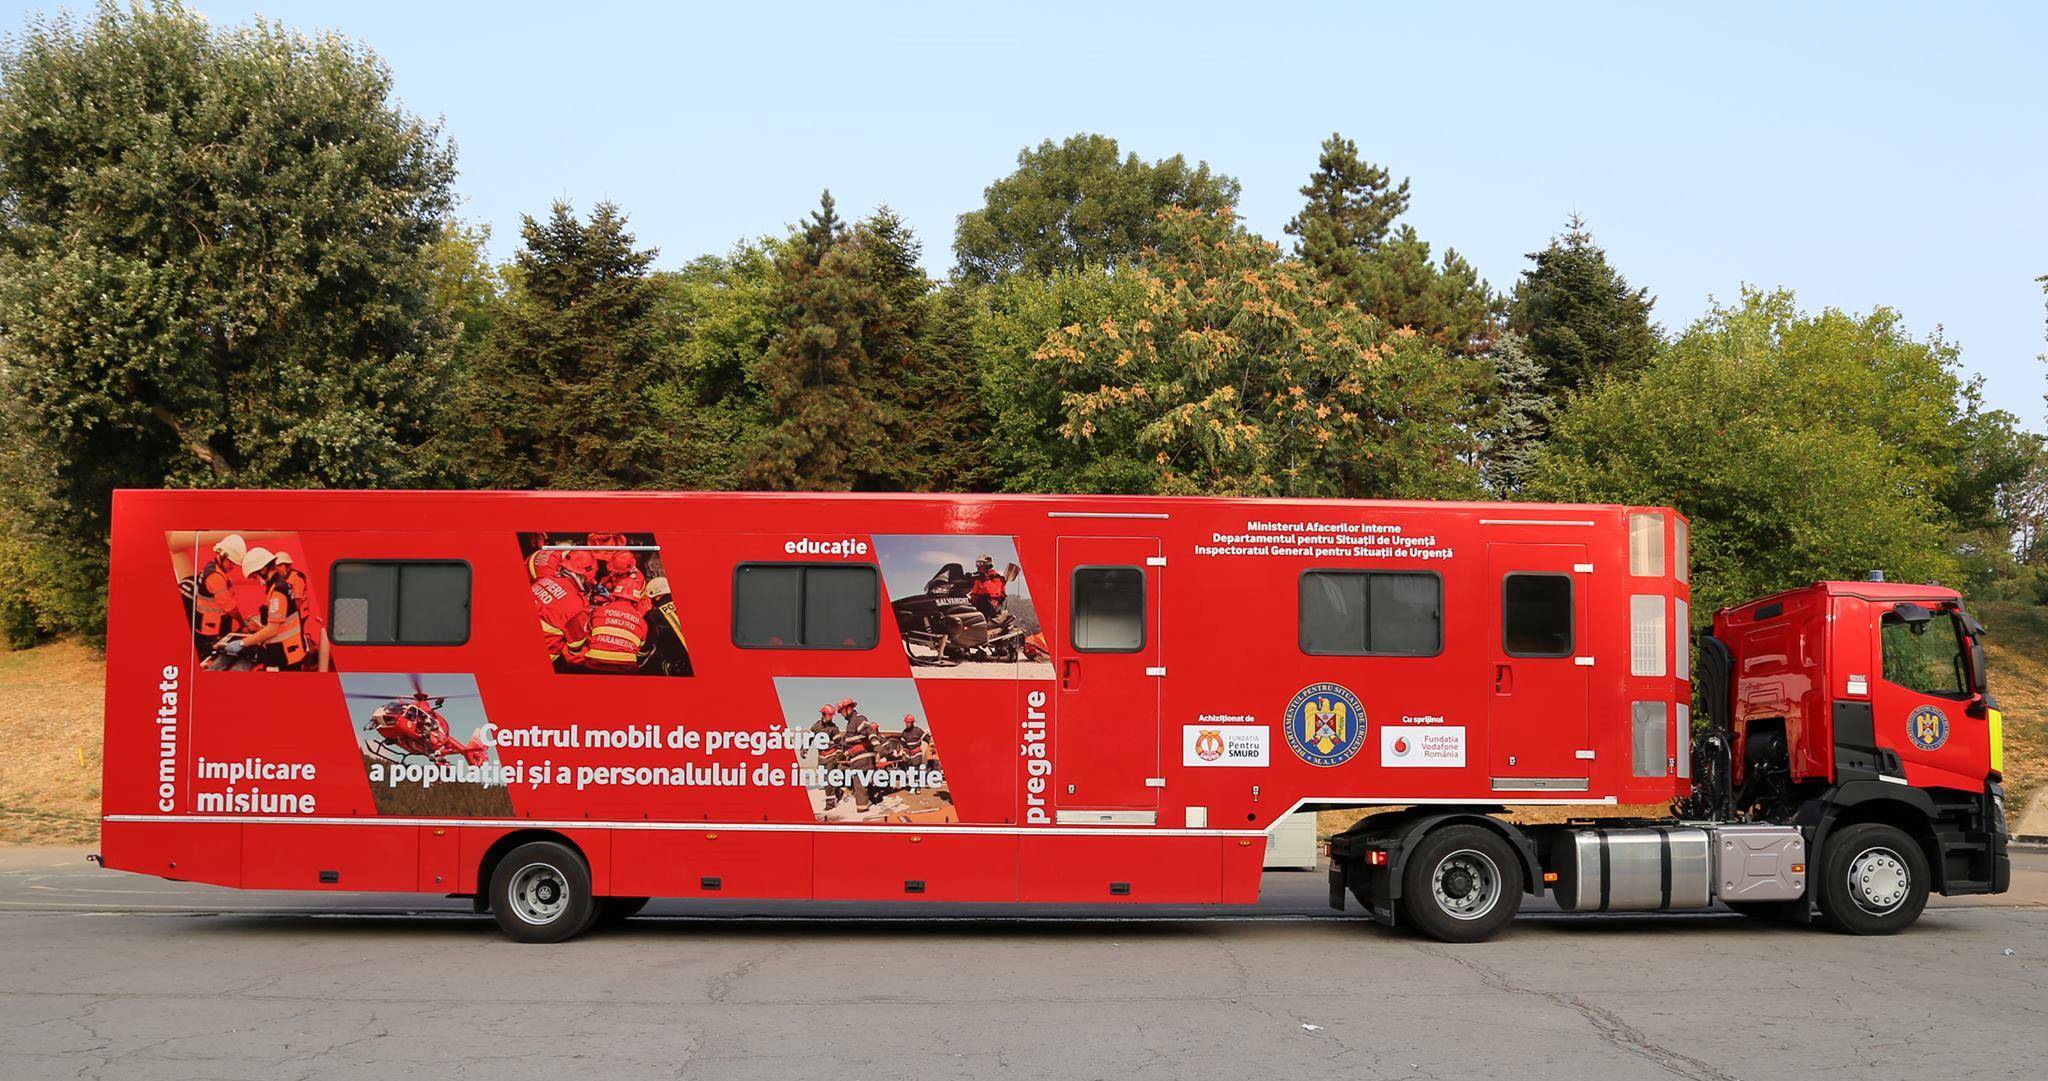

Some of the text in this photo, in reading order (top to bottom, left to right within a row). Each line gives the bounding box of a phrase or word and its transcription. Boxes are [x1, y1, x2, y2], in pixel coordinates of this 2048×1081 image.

[1247, 521, 1402, 533] Ministerul Afacerilor Interne
[784, 537, 868, 559] educație
[1212, 533, 1436, 548] Departamentul pentru Situații de Urgență
[1194, 545, 1454, 560] Inspectoratul General pentru Situații de Urgență
[1303, 685, 1334, 696] PENTRU
[1245, 714, 1255, 723] de
[1402, 715, 1444, 725] Cu sprijinul
[156, 665, 179, 812] comunitate
[480, 723, 830, 755] Centrul mobil de pregătire
[1228, 741, 1260, 750] Pentru
[1228, 749, 1260, 758] SMURD
[1421, 743, 1459, 751] Vodafone
[1424, 750, 1459, 758] România
[1020, 690, 1053, 825] pregătire
[197, 756, 316, 785] implicare
[369, 763, 384, 782] a
[389, 760, 523, 790] populației
[528, 759, 551, 791] și
[556, 765, 571, 785] a
[576, 761, 747, 791] personalului
[752, 763, 786, 787] de
[197, 786, 316, 814] misiune
